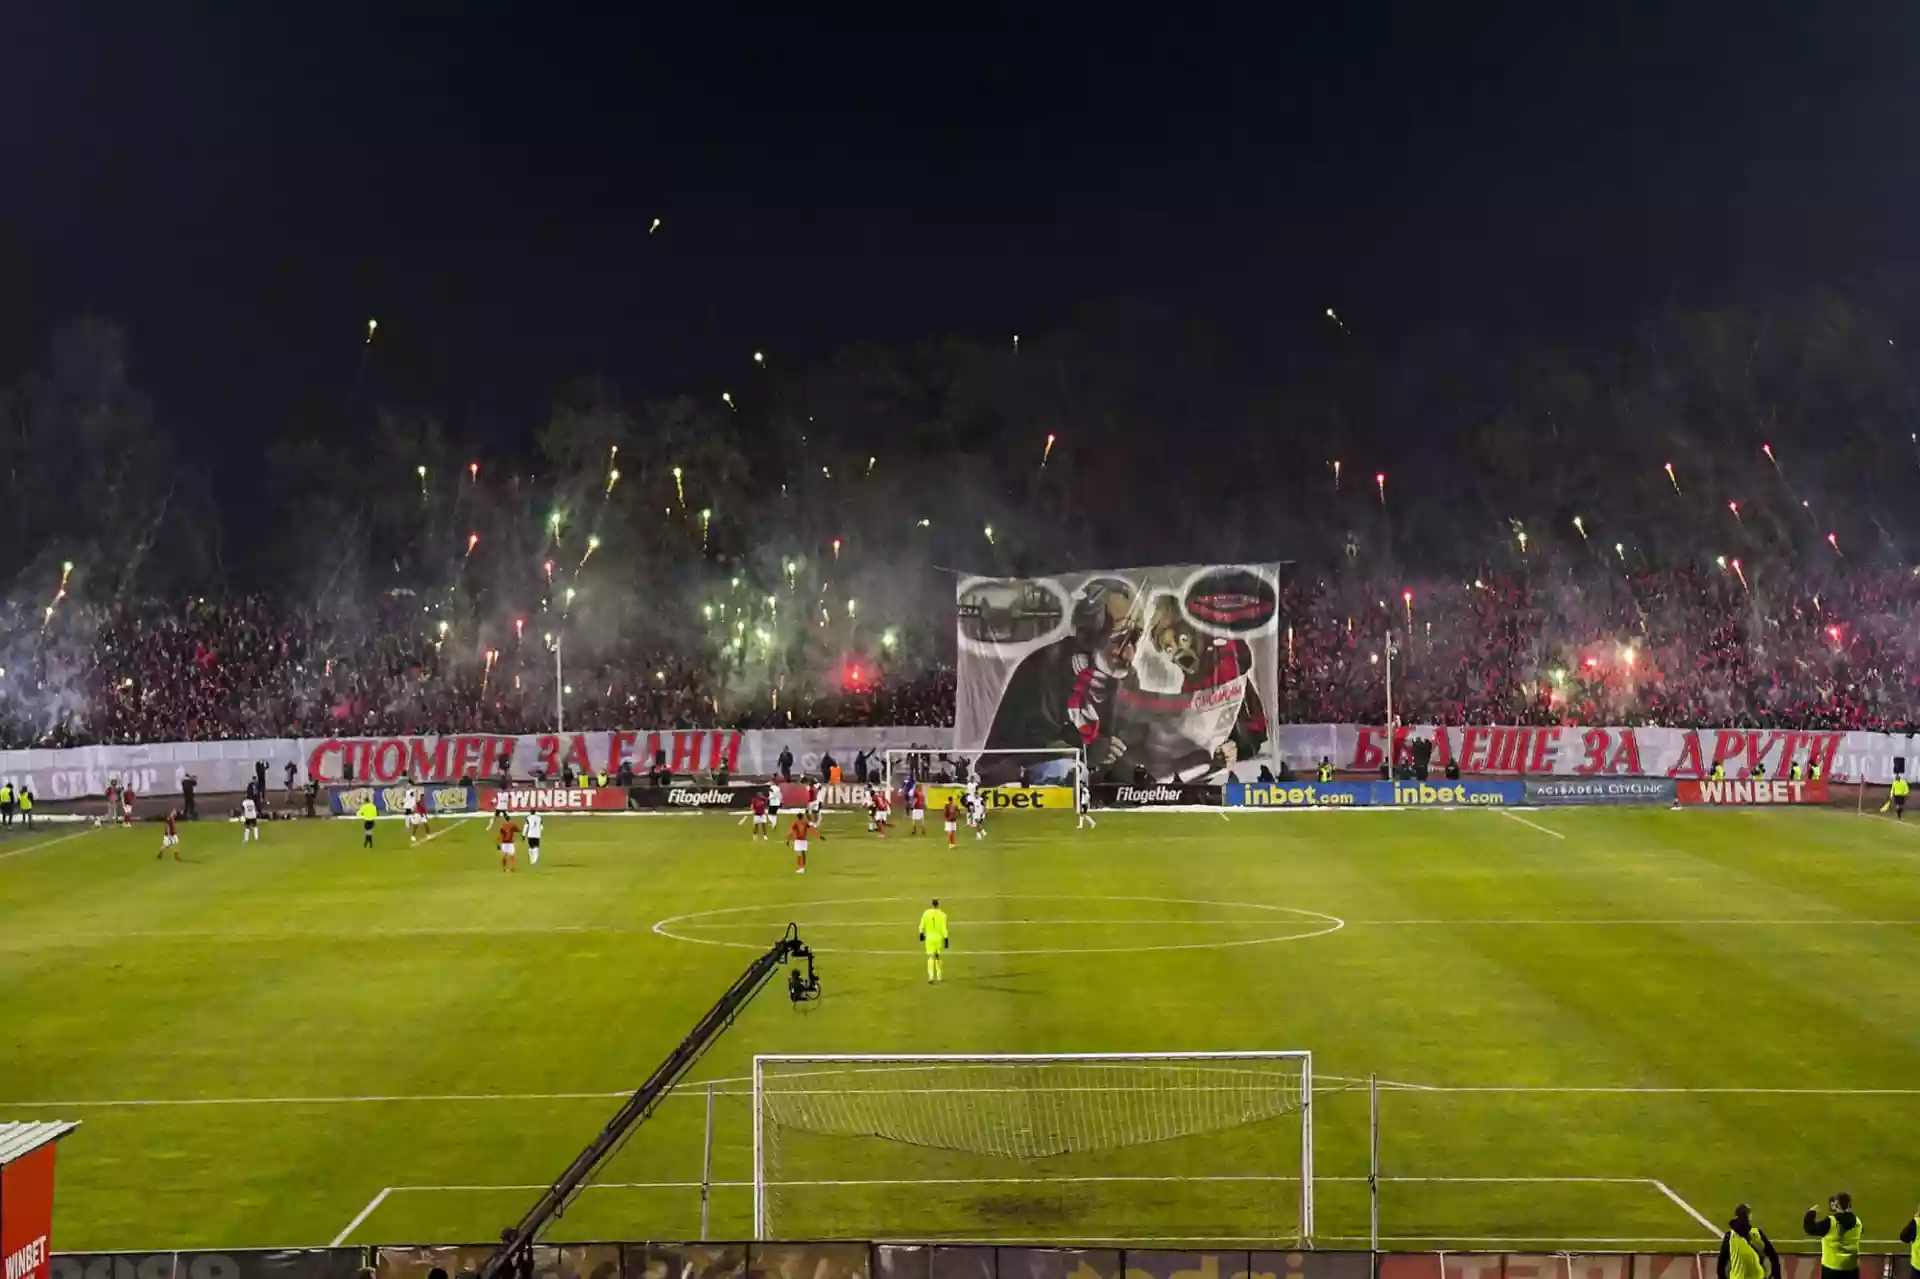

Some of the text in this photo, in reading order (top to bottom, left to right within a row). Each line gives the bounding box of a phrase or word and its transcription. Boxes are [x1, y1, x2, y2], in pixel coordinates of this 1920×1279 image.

[308, 734, 517, 783] СПОМЕН
[537, 733, 594, 776] ЗА
[1572, 728, 1645, 776] ЗА
[510, 789, 596, 808] WINBET
[668, 788, 735, 806] Fitogether
[1116, 785, 1183, 804] Fitogether
[1244, 783, 1353, 805] inbet.com
[1394, 781, 1504, 804] inbet.com
[1699, 780, 1806, 804] WINBET
[5, 1235, 47, 1279] WINBET
